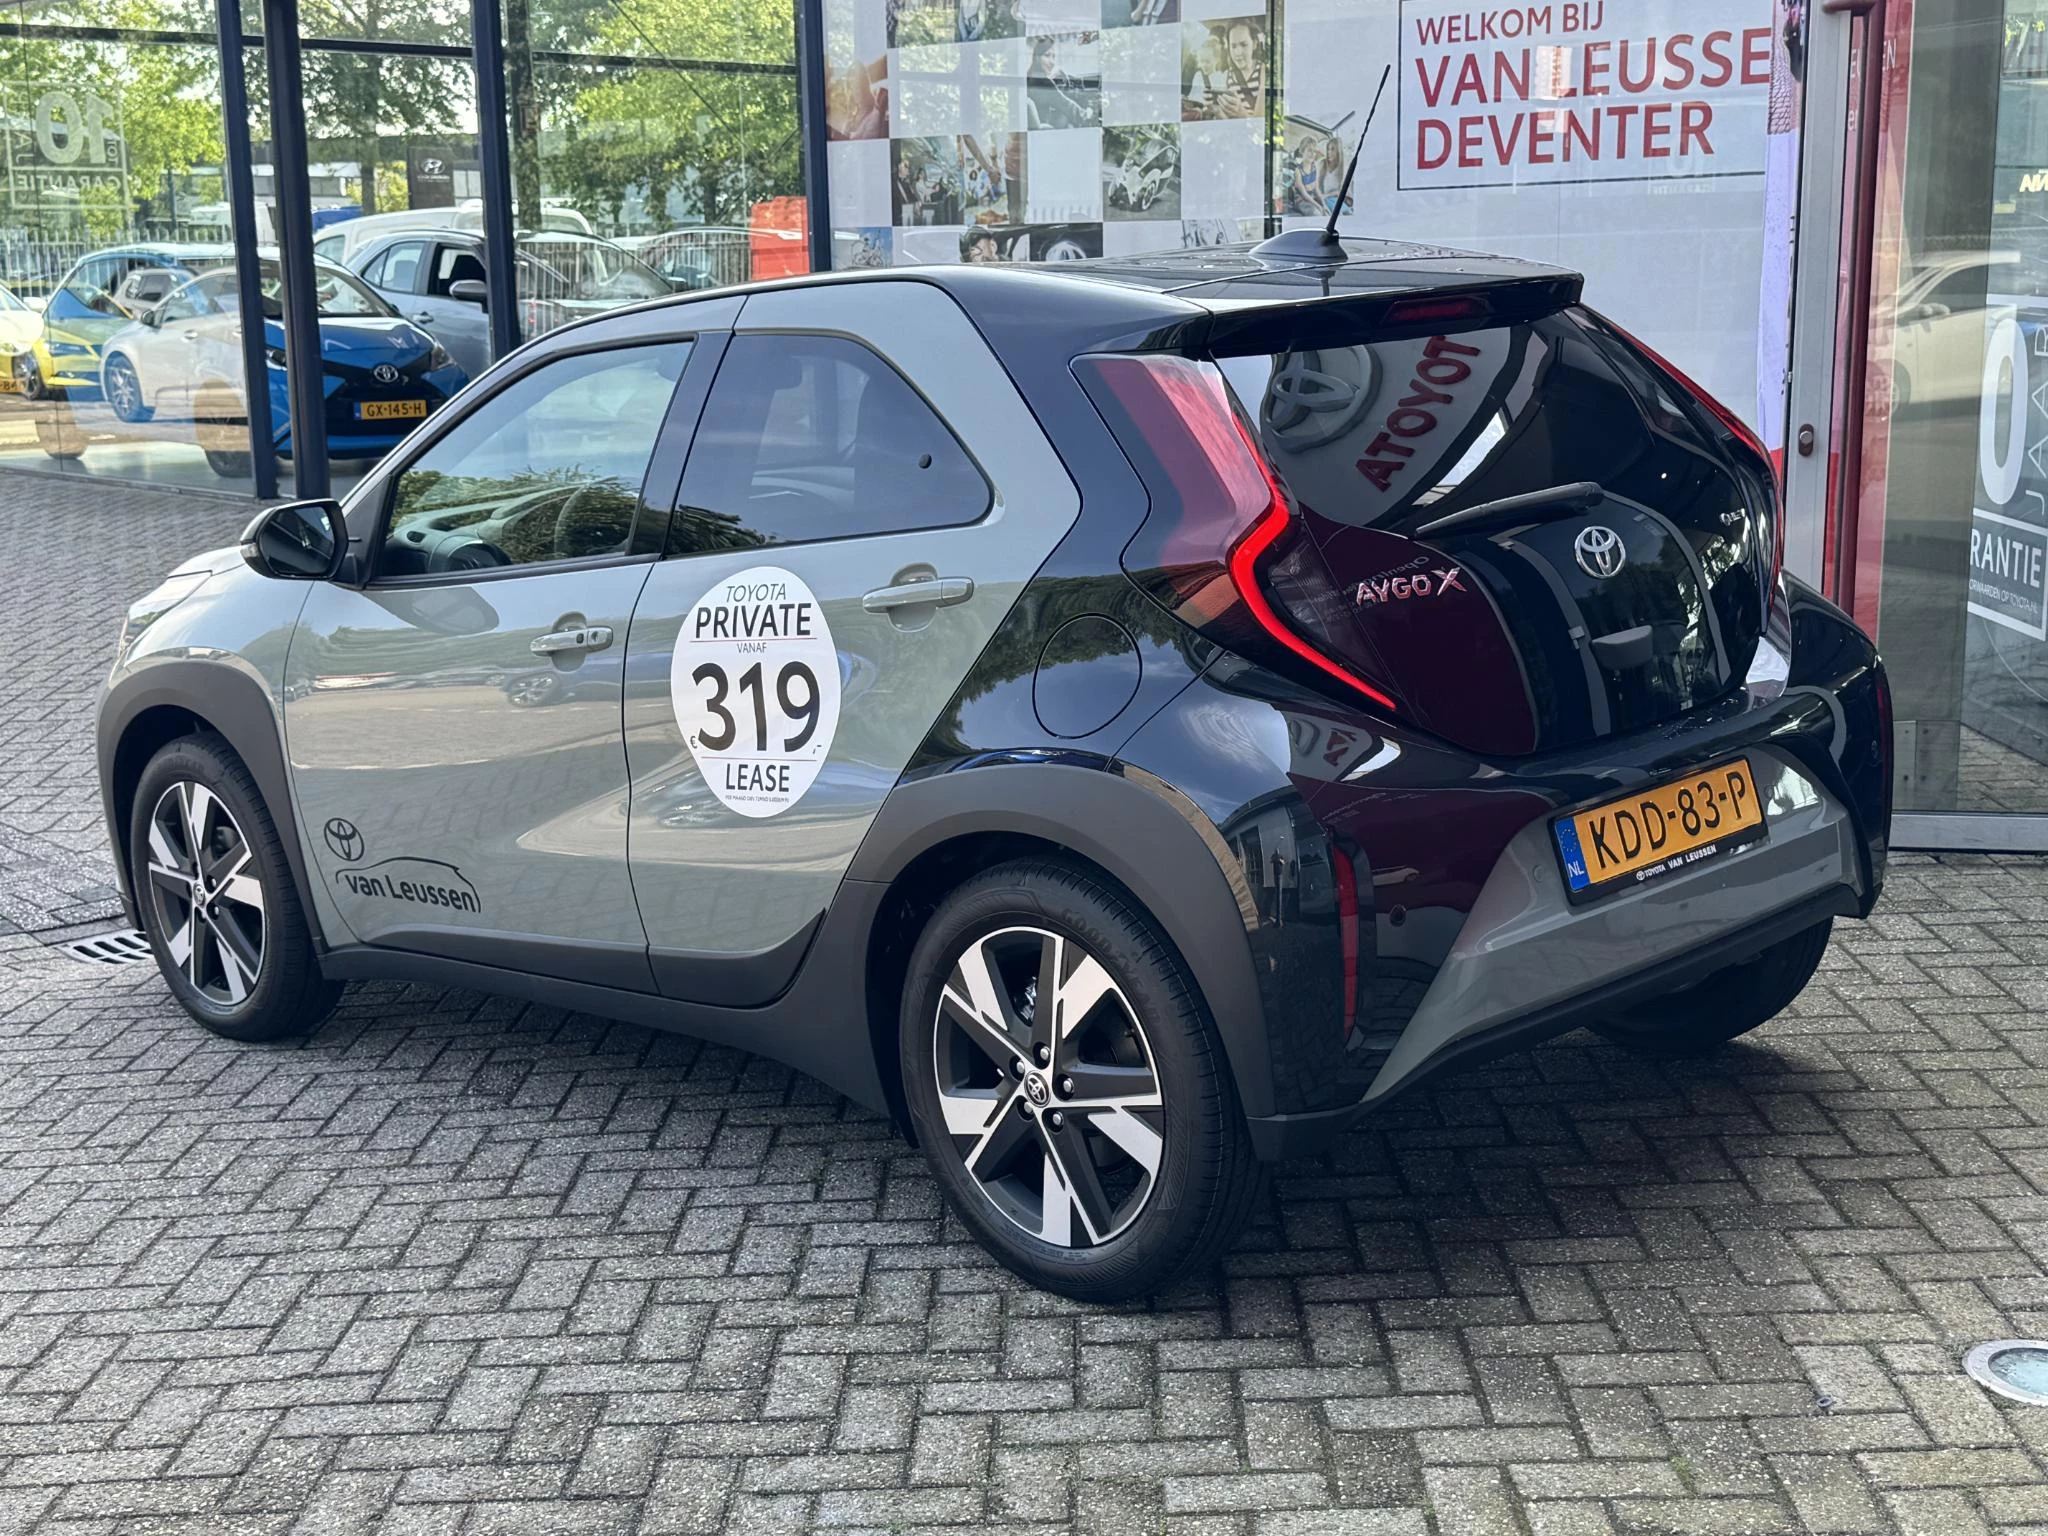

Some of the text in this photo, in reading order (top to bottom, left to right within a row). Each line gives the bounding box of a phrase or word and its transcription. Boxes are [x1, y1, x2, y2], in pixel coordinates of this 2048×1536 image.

[1416, 0, 1604, 46] WELKOM BIJ
[1415, 48, 1531, 108] VAN
[1417, 100, 1715, 170] DEVENTER
[1970, 528, 2042, 588] RANTIE
[726, 583, 787, 602] TOYOTA
[1356, 574, 1432, 606] AYGO
[1431, 566, 1468, 596] X
[695, 602, 812, 639] PRIVATE
[737, 642, 768, 654] VANAF
[726, 763, 790, 792] LEASE
[1588, 771, 1747, 870] KDD-83-P
[1567, 861, 1585, 878] NL
[1644, 844, 1717, 878] TOYOTA VAN LEUSSEN
[344, 874, 477, 913] van Leussen
